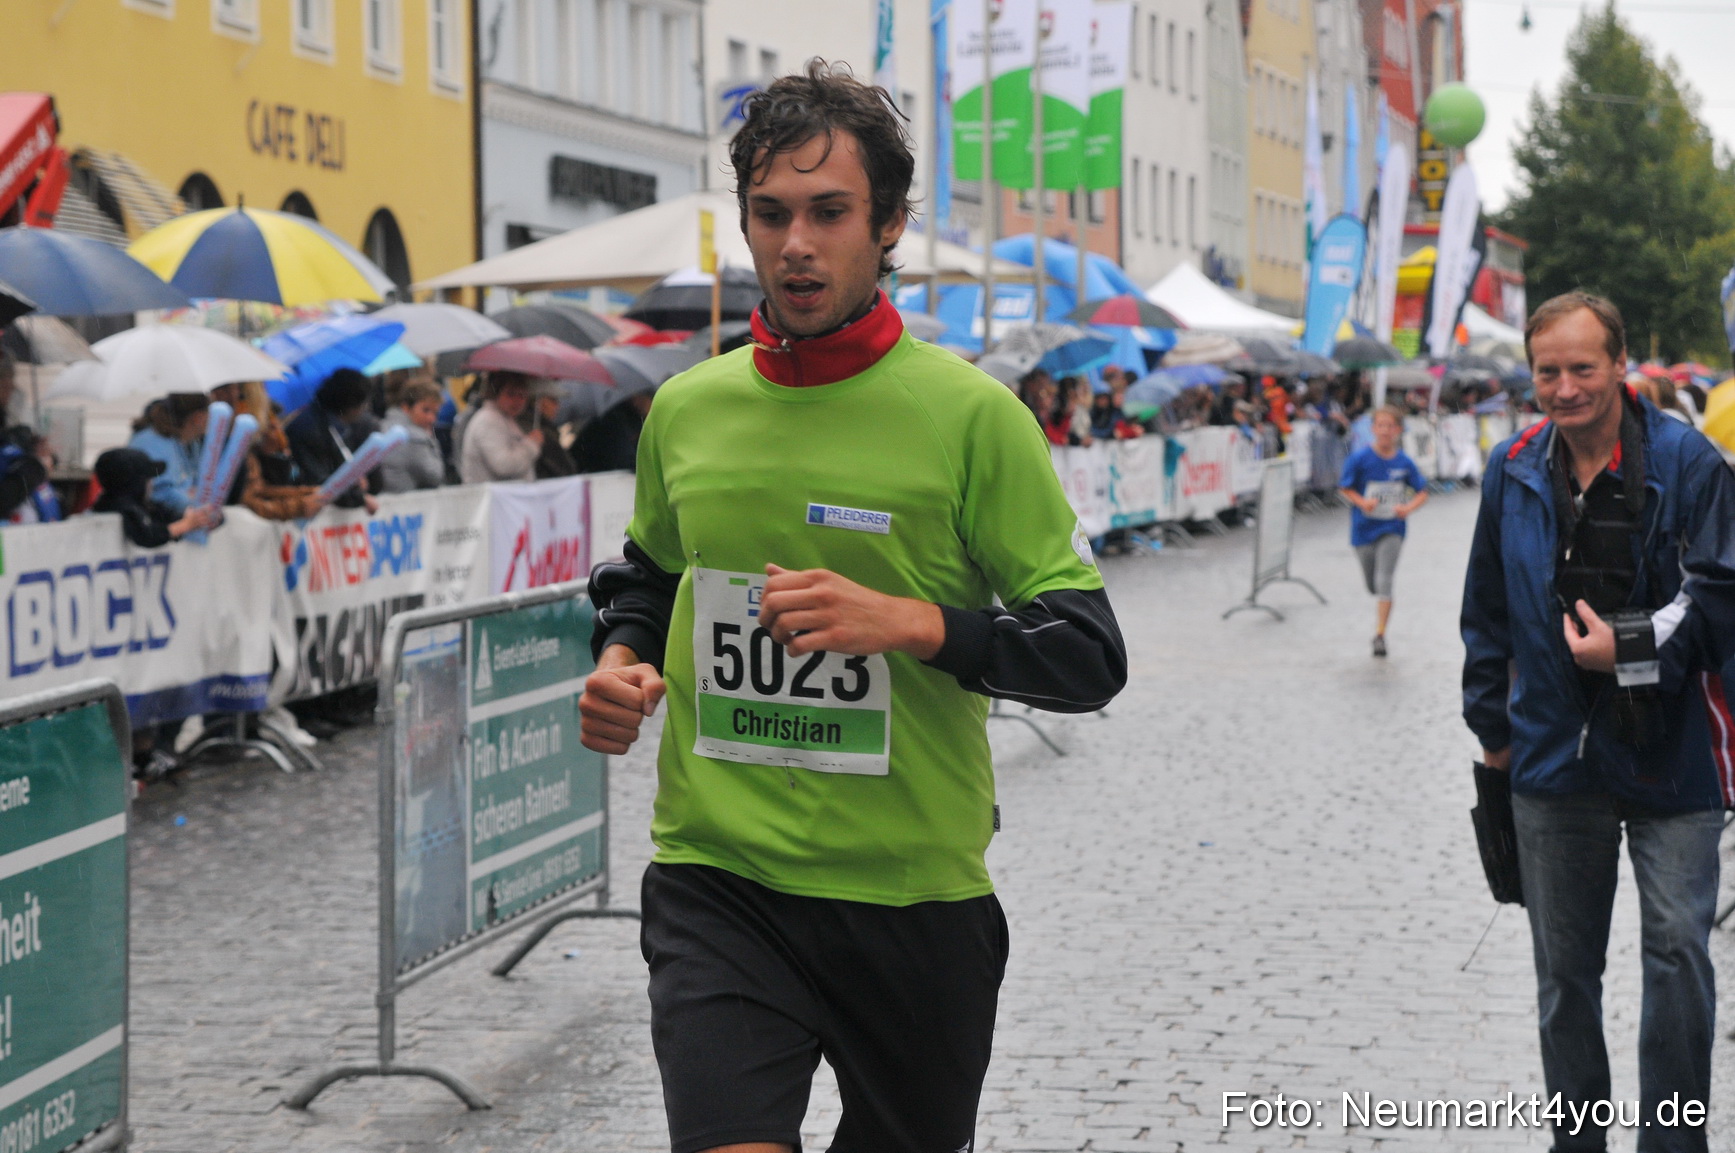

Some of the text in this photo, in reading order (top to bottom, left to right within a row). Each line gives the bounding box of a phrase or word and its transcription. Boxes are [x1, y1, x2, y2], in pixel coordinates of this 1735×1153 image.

[246, 99, 345, 171] CAFE DELI
[826, 507, 889, 526] PFLEIDERER
[307, 513, 423, 592] INTERSPORT
[8, 554, 176, 677] BOCK
[702, 679, 709, 691] S
[713, 622, 870, 702] 5023
[511, 719, 549, 768] Action
[549, 713, 561, 754] in
[733, 708, 841, 744] Christian
[43, 1089, 76, 1139] 6352
